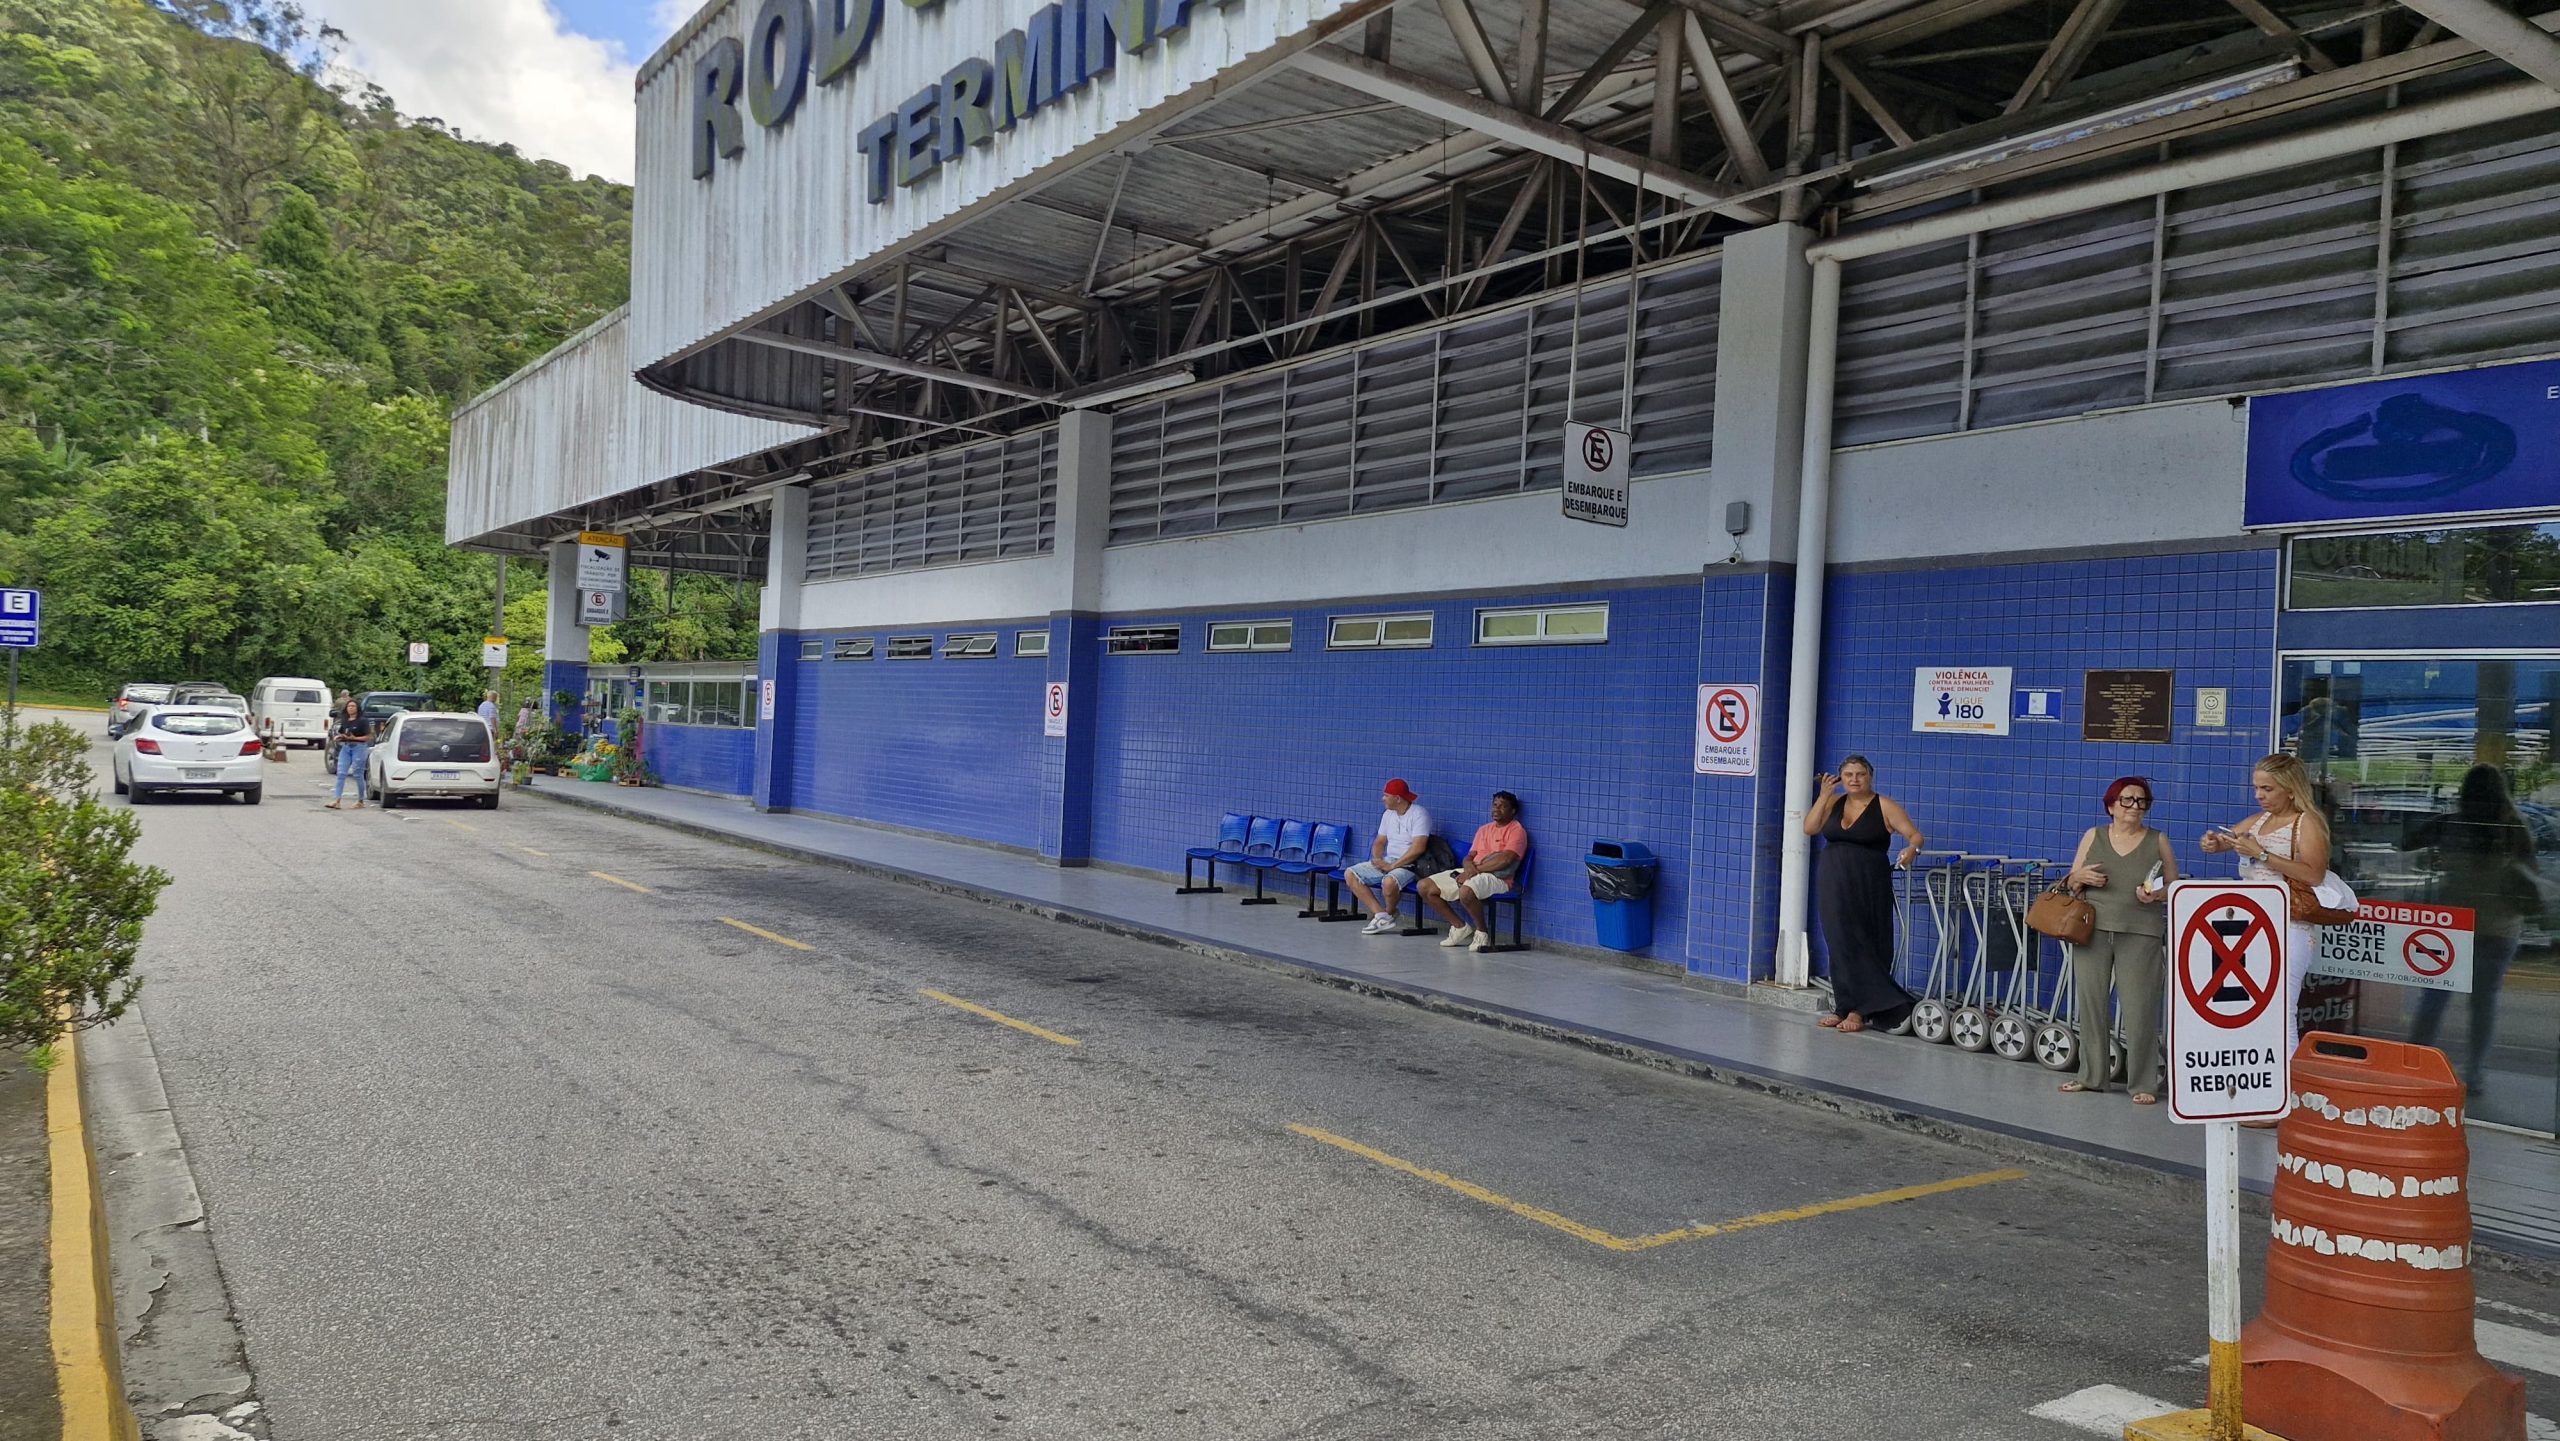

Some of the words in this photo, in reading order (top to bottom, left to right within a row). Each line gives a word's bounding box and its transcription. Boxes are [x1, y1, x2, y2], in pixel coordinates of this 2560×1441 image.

[692, 0, 947, 179] ROD
[1567, 481, 1614, 500] EMBARQUE
[1617, 490, 1623, 502] E
[1564, 497, 1627, 519] DESEMBARQUE
[12, 595, 24, 610] E
[1935, 669, 1988, 680] VIOLÊNCIA
[1954, 696, 1984, 705] LIGUE
[1956, 704, 1984, 719] 180
[1704, 745, 1741, 755] EMBARQUE
[1742, 747, 1747, 755] E
[1701, 755, 1750, 766] DESEMBARQUE
[2357, 904, 2453, 926] ROIBIDO
[2321, 933, 2386, 950] NESTE
[2321, 946, 2385, 964] LOCAL
[2321, 965, 2336, 973] LEI
[2373, 971, 2384, 979] de
[2386, 973, 2435, 985] 17/08/2009
[2443, 979, 2455, 987] RJ
[2185, 1048, 2259, 1068] SUJEITO
[2264, 1048, 2276, 1064] A
[2190, 1071, 2273, 1093] REBOQUE
